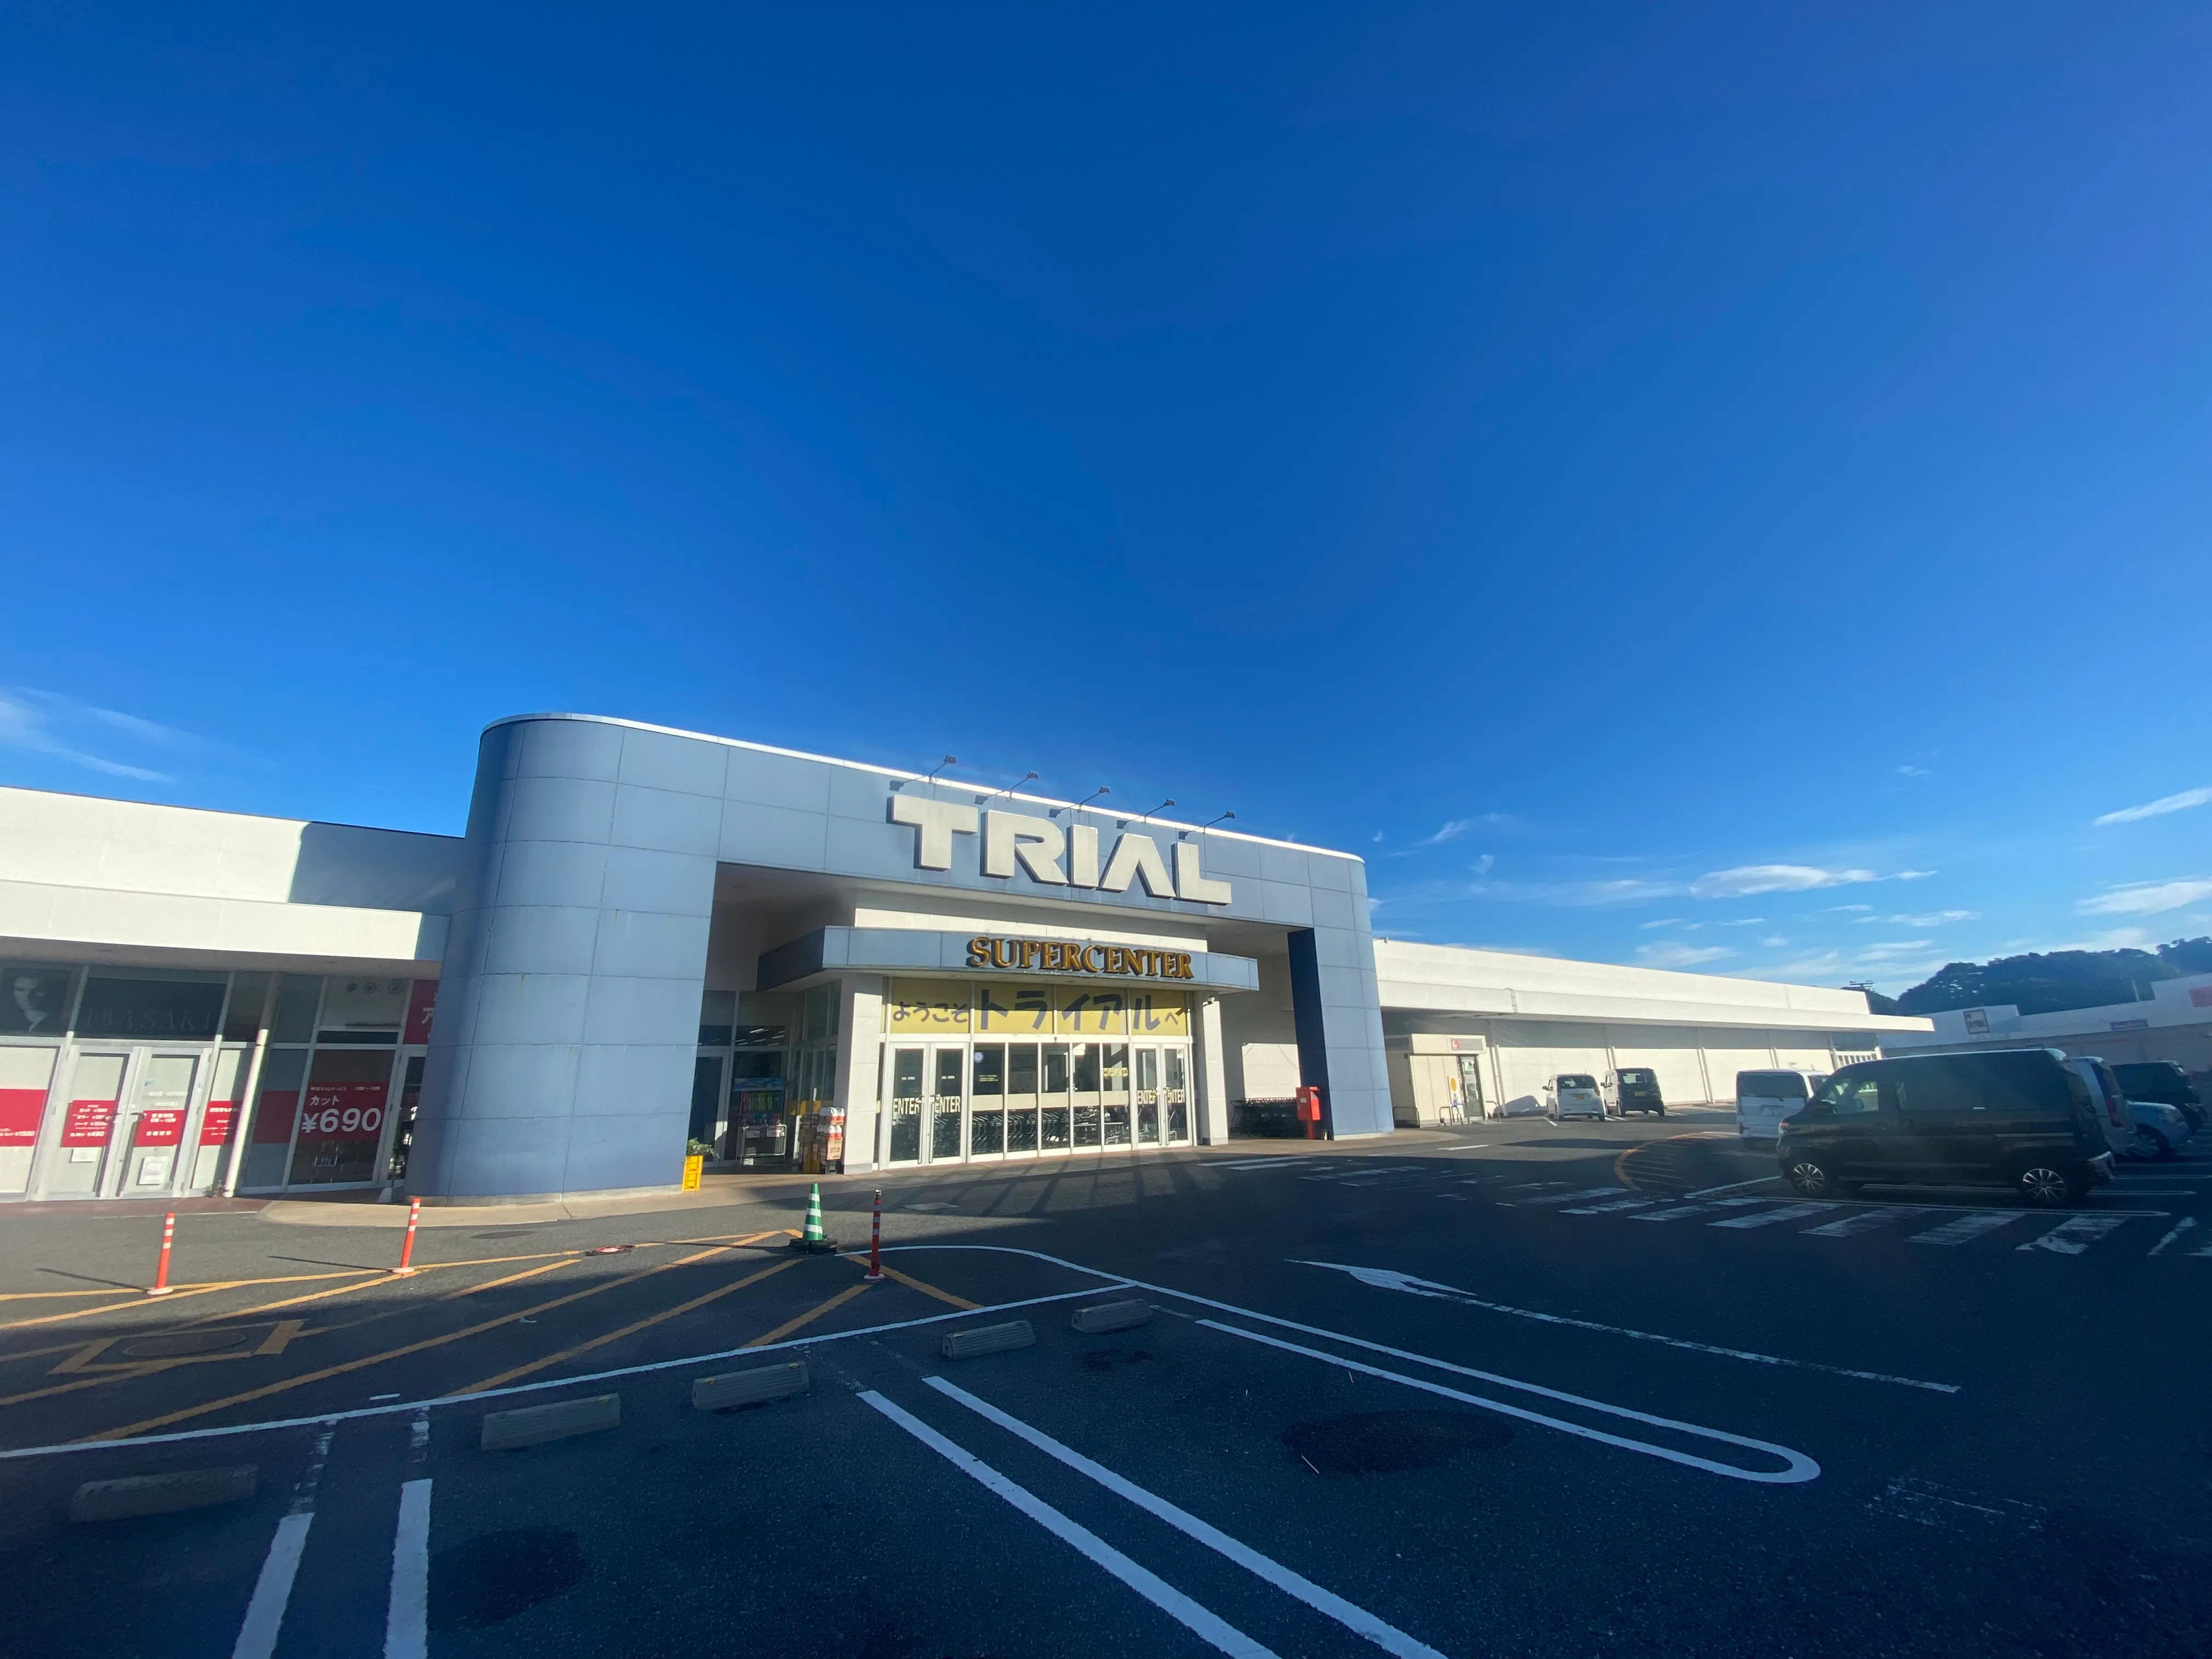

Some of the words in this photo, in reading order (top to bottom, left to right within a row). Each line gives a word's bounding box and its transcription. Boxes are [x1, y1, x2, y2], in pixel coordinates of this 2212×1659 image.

[887, 794, 1233, 906] TRIAL
[966, 936, 1195, 979] SUPERCENTER
[893, 1001, 968, 1024] ようこそ
[980, 989, 1180, 1031] トライアルへ
[302, 1108, 381, 1133] ¥690
[310, 1095, 340, 1106] カット
